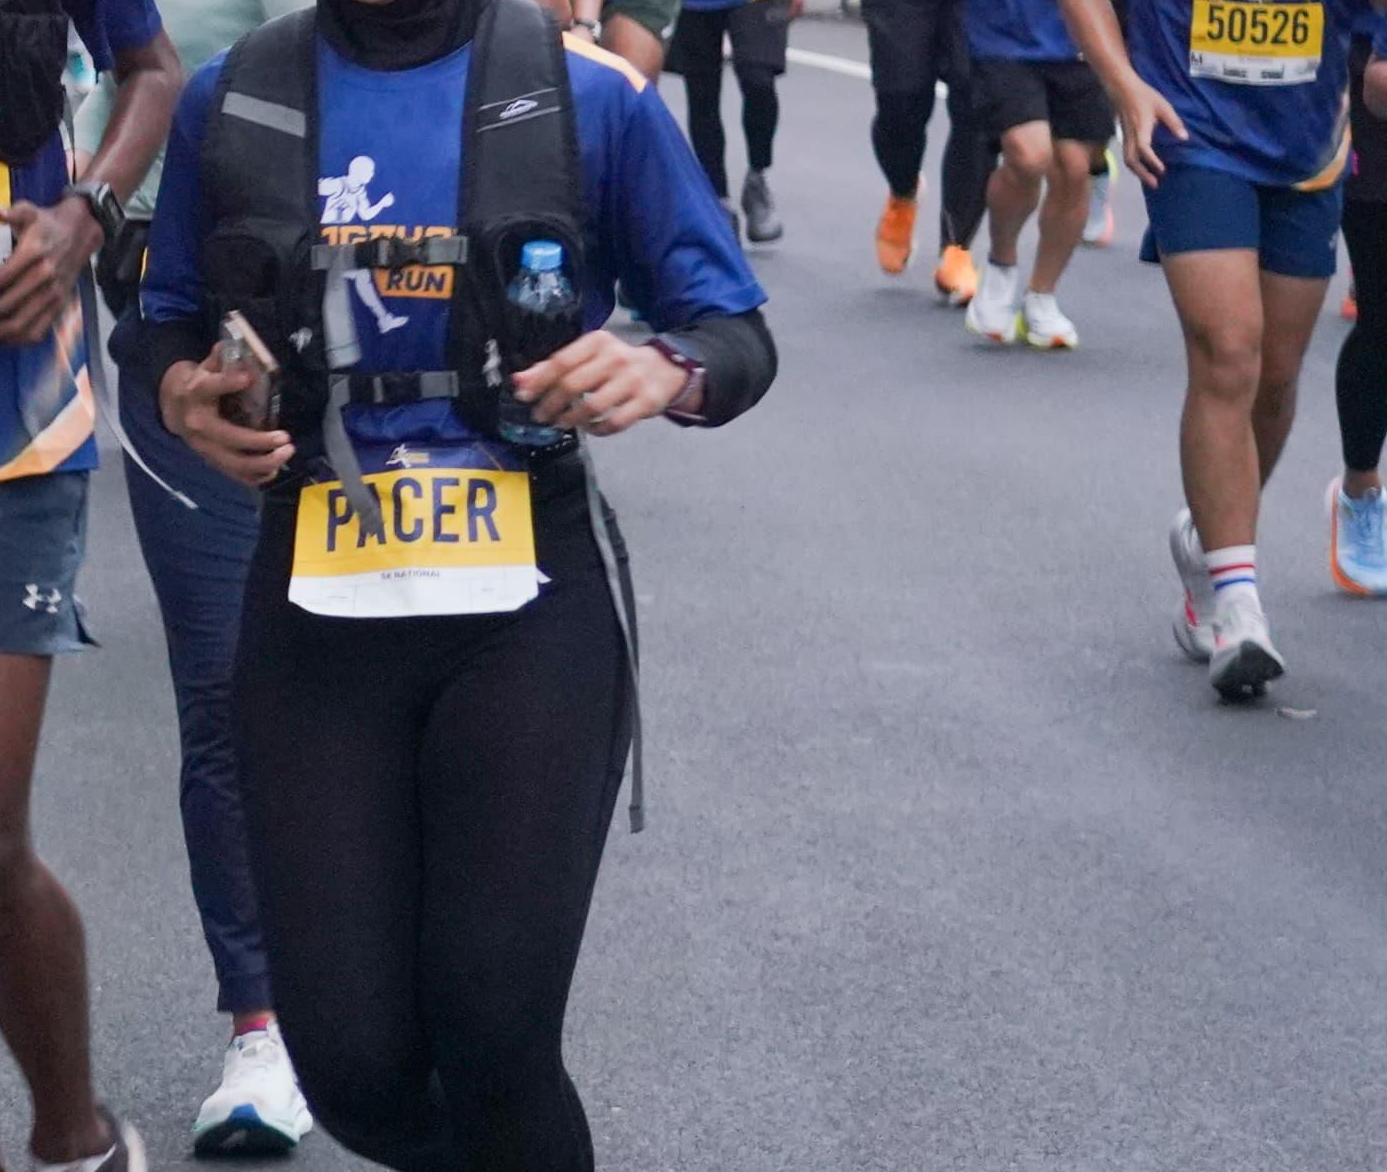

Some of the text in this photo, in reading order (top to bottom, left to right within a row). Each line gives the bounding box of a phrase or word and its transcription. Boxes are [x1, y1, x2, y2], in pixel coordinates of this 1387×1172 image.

[1206, 3, 1310, 45] 50526
[386, 267, 446, 292] RUN
[326, 477, 502, 553] PACER
